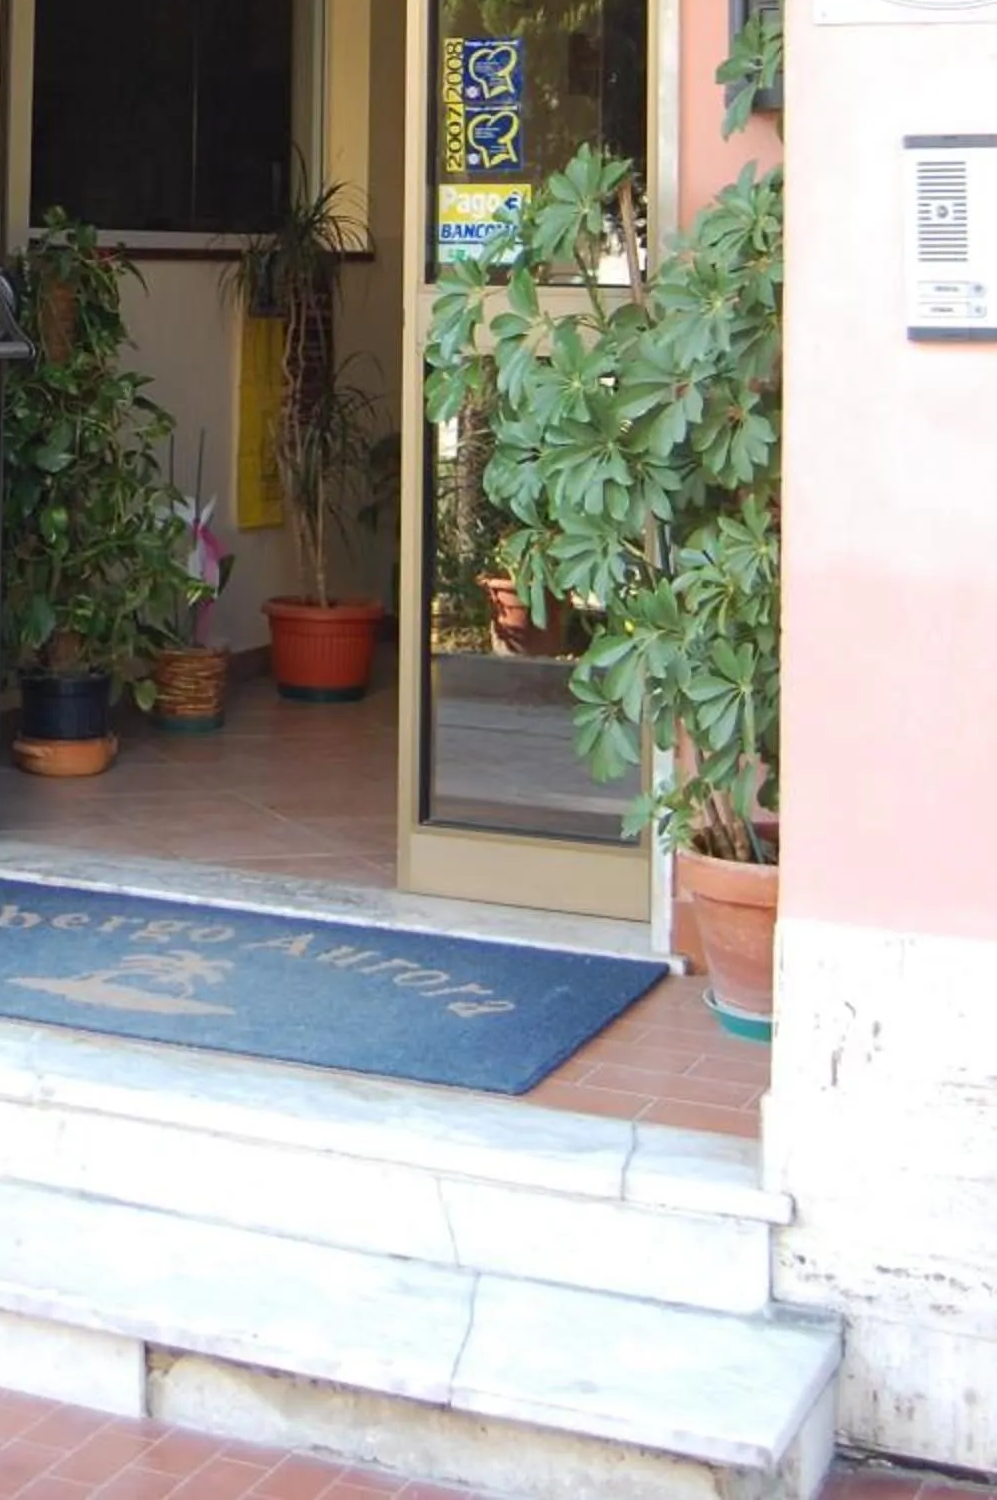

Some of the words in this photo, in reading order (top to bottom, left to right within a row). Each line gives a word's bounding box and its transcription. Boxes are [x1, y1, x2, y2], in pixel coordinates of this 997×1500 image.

[446, 41, 462, 101] 2008
[448, 106, 462, 169] 2007
[441, 186, 503, 220] Pago
[240, 932, 515, 1018] Aurora
